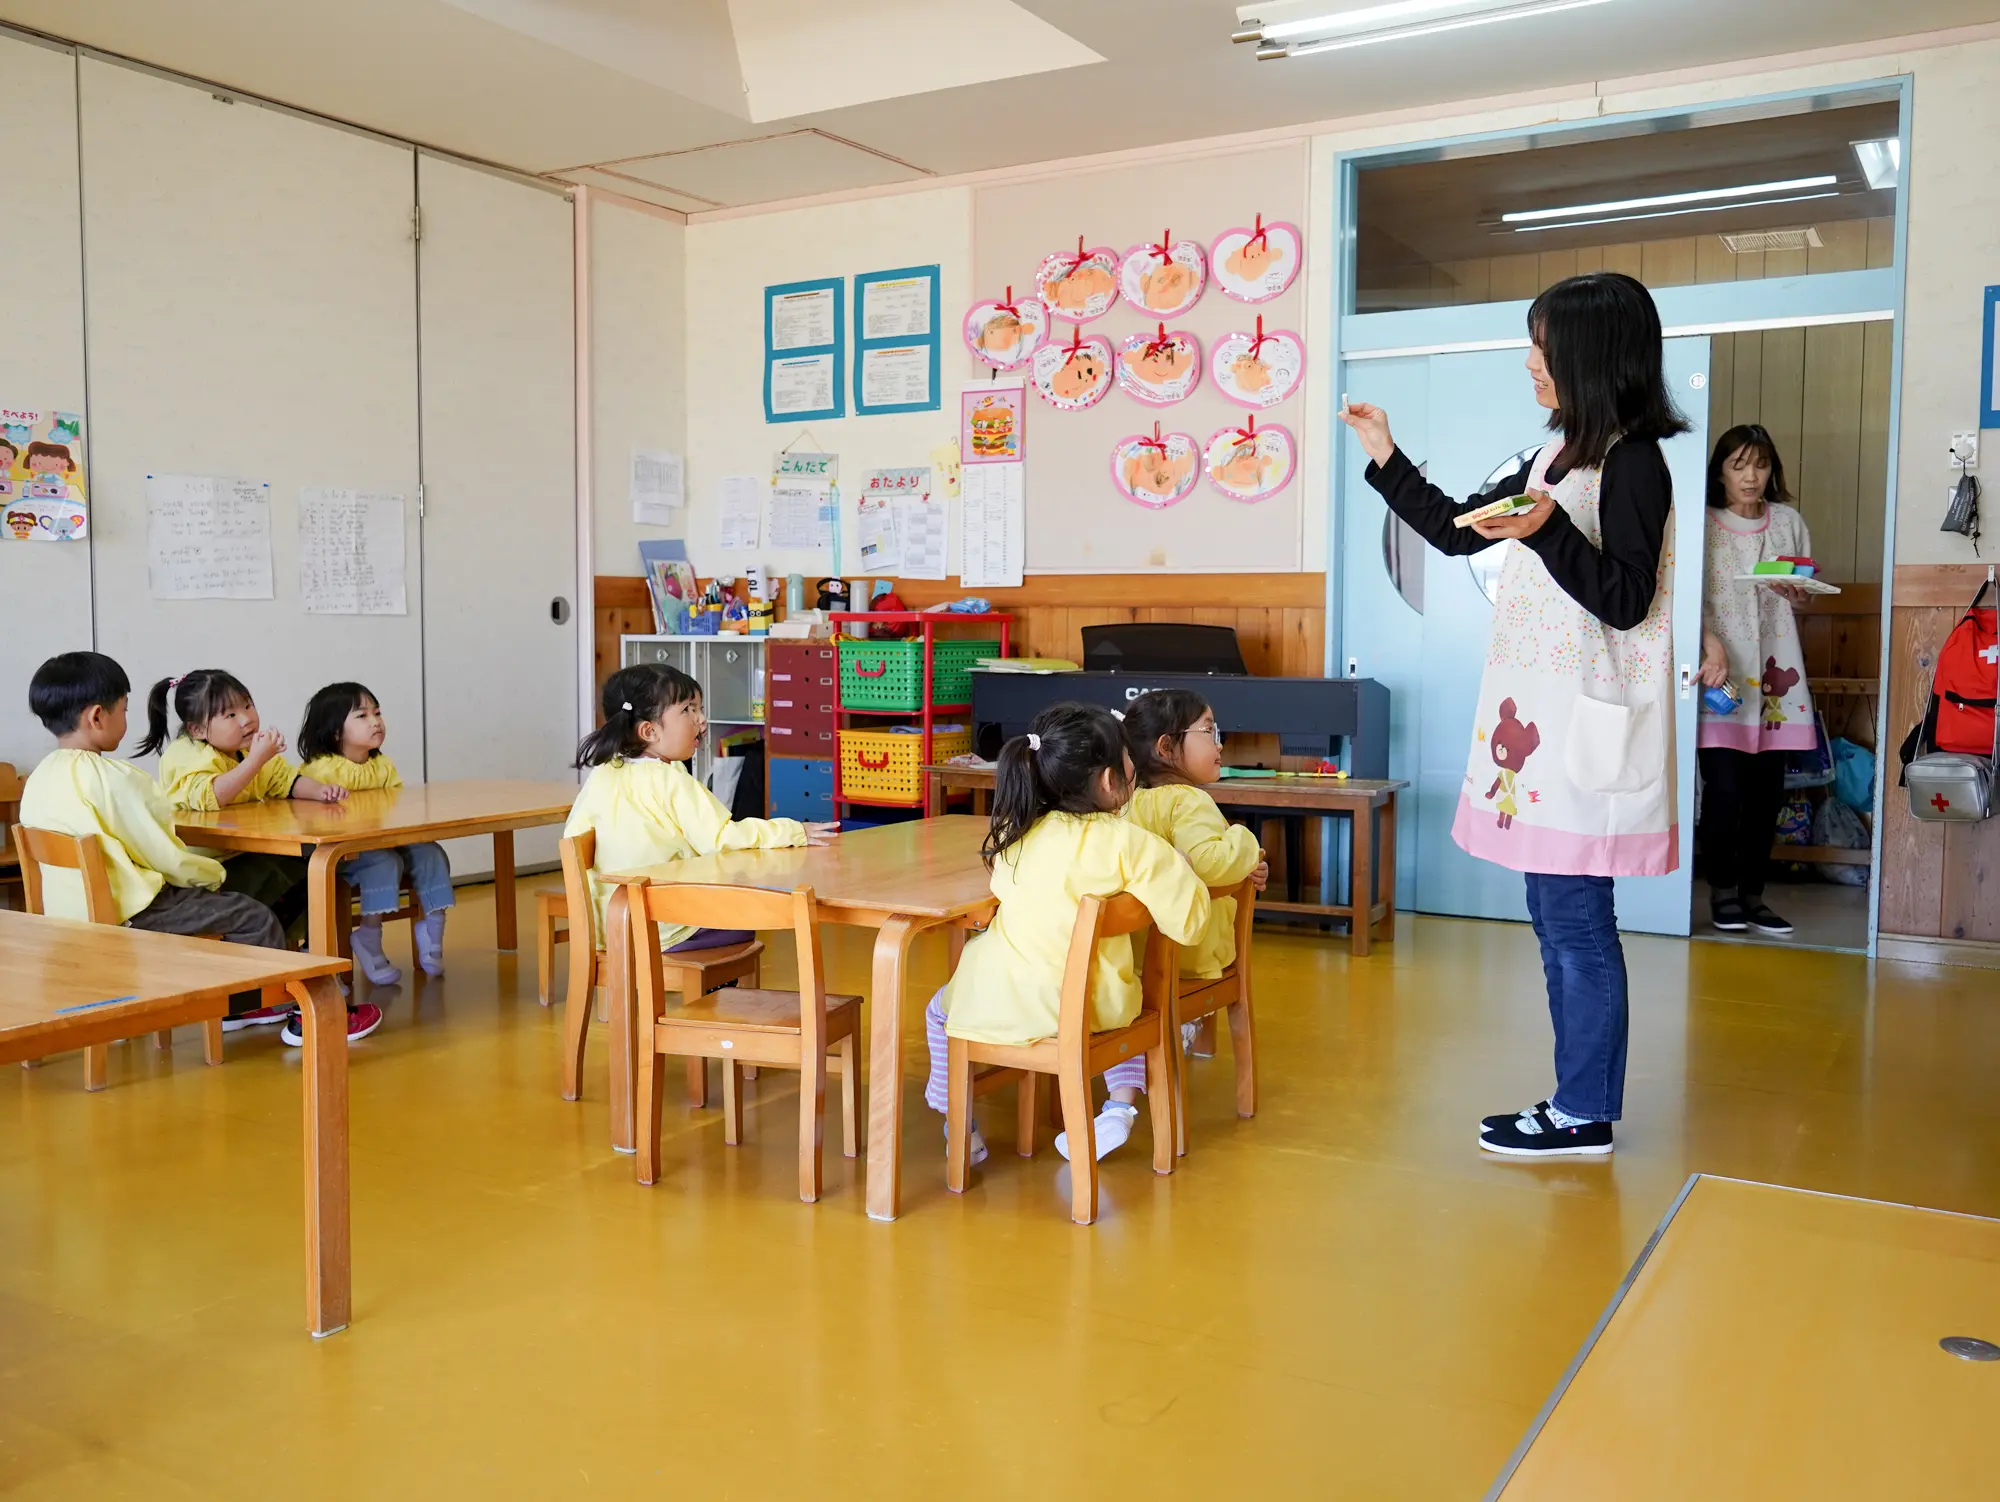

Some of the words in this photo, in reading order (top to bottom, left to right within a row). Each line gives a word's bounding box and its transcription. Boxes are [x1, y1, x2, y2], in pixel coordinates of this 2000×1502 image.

[2, 409, 39, 421] たべよう!
[870, 476, 919, 489] おたより
